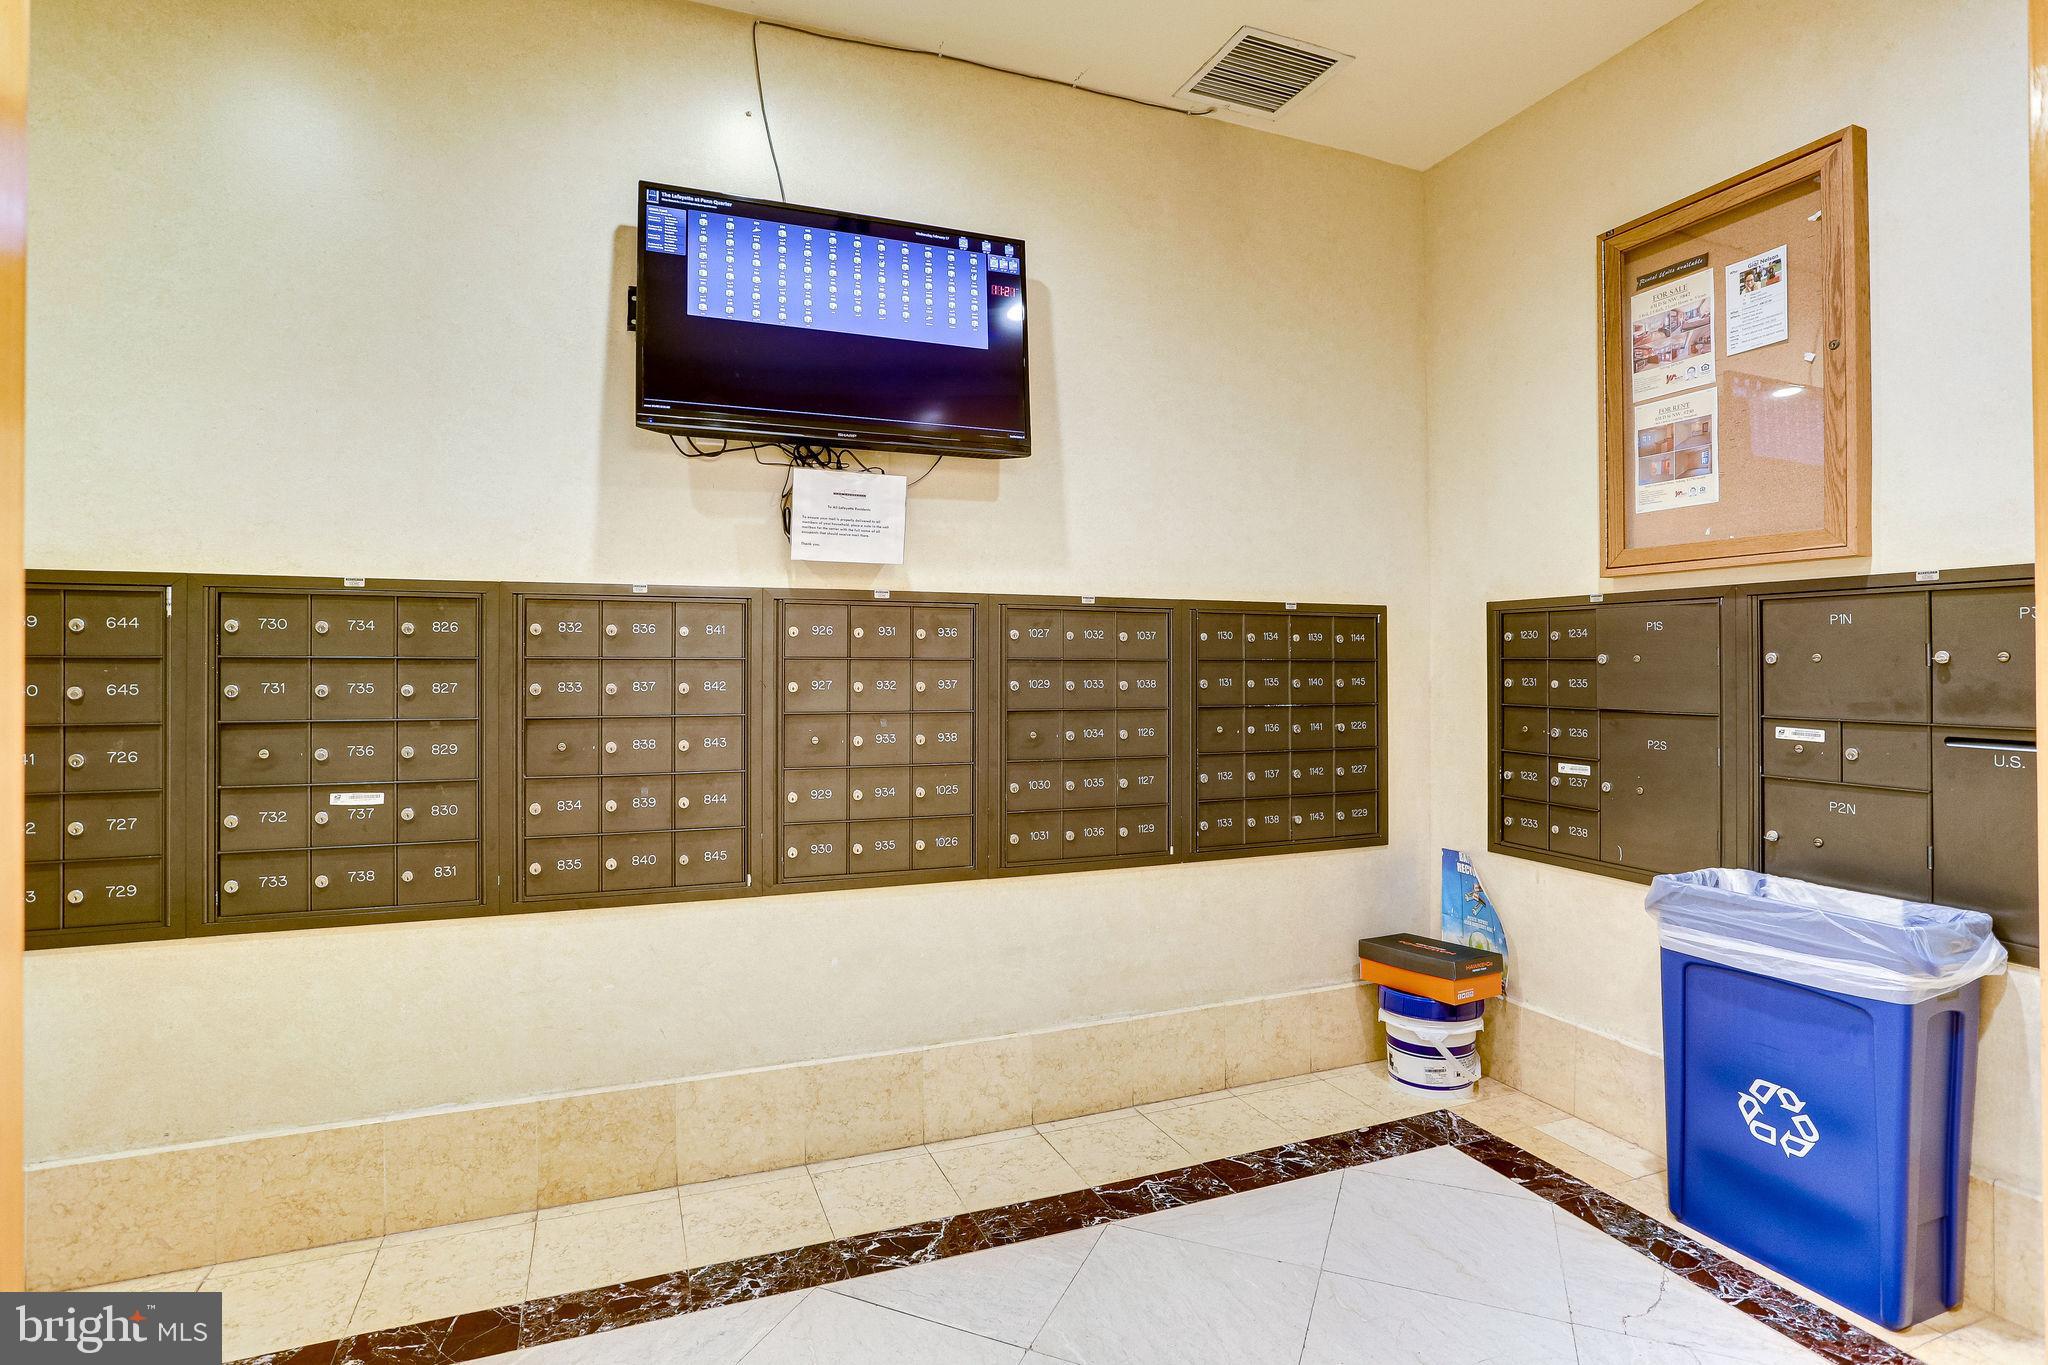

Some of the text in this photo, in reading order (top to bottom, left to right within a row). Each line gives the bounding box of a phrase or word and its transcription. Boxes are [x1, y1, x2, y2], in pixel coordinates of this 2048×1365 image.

[1652, 291, 1668, 302] FOR
[106, 616, 140, 629] 644
[258, 618, 288, 630] 730
[1829, 613, 1852, 625] P1N
[347, 619, 375, 631] 734
[432, 621, 459, 633] 826
[558, 621, 583, 633] 832
[632, 623, 656, 634] 836
[705, 624, 726, 635] 841
[811, 625, 834, 636] 926
[1646, 620, 1664, 632] P1S
[878, 626, 896, 637] 931
[937, 627, 958, 638] 936
[1028, 628, 1050, 638] 1027
[1083, 629, 1104, 640] 1032
[1136, 630, 1157, 641] 1037
[1217, 630, 1234, 640] 1130
[1263, 631, 1279, 641] 1134
[1307, 632, 1323, 642] 1139
[1520, 629, 1539, 640] 1230
[1568, 628, 1588, 639] 1234
[1350, 633, 1366, 642] 1144
[557, 681, 583, 693] 833
[632, 681, 656, 692] 837
[703, 680, 727, 692] 842
[811, 680, 833, 691] 927
[876, 680, 897, 690] 932
[937, 679, 958, 690] 937
[1028, 679, 1051, 689] 1029
[1083, 679, 1105, 689] 1033
[1136, 679, 1157, 689] 1038
[1218, 677, 1232, 687] 1131
[1263, 677, 1280, 687] 1135
[1308, 677, 1324, 687] 1140
[1351, 677, 1366, 686] 1145
[1521, 677, 1537, 687] 1231
[1568, 678, 1589, 688] 1235
[106, 683, 140, 696] 645
[260, 682, 285, 694] 731
[347, 682, 375, 694] 735
[431, 682, 458, 694] 827
[1264, 723, 1280, 732] 1136
[1310, 722, 1323, 731] 1141
[1350, 720, 1367, 730] 1226
[937, 732, 958, 743] 938
[1083, 728, 1105, 739] 1034
[1137, 727, 1155, 737] 1126
[1568, 727, 1589, 738] 1236
[632, 738, 656, 750] 838
[703, 737, 727, 748] 843
[875, 733, 897, 744] 933
[431, 743, 458, 755] 829
[1647, 739, 1667, 751] P2S
[346, 745, 375, 757] 736
[106, 750, 138, 764] 726
[1994, 754, 2026, 769] U.S.
[1264, 769, 1280, 779] 1137
[1309, 766, 1324, 776] 1142
[1351, 764, 1368, 774] 1227
[1137, 775, 1155, 785] 1127
[1217, 771, 1233, 781] 1132
[1520, 770, 1538, 782] 1232
[1028, 779, 1051, 790] 1030
[1083, 777, 1105, 788] 1035
[1568, 777, 1588, 788] 1237
[810, 789, 833, 800] 929
[874, 787, 896, 798] 934
[935, 784, 959, 795] 1025
[632, 797, 657, 809] 839
[703, 793, 728, 805] 844
[430, 804, 459, 817] 830
[557, 799, 582, 812] 834
[1829, 801, 1856, 815] P2N
[258, 810, 288, 823] 732
[347, 807, 375, 820] 737
[1309, 811, 1325, 821] 1143
[1351, 808, 1368, 818] 1229
[106, 817, 138, 831] 727
[1217, 817, 1233, 828] 1133
[1264, 814, 1280, 824] 1138
[1520, 817, 1539, 829] 1233
[1083, 826, 1105, 837] 1036
[1137, 823, 1155, 834] 1129
[1568, 825, 1588, 838] 1238
[1030, 830, 1049, 841] 1031
[874, 839, 896, 851] 935
[935, 836, 958, 847] 1026
[810, 843, 833, 855] 930
[631, 854, 657, 866] 840
[703, 850, 728, 862] 845
[556, 858, 582, 871] 835
[347, 870, 375, 883] 738
[434, 865, 457, 878] 831
[258, 875, 288, 888] 733
[105, 884, 138, 898] 729
